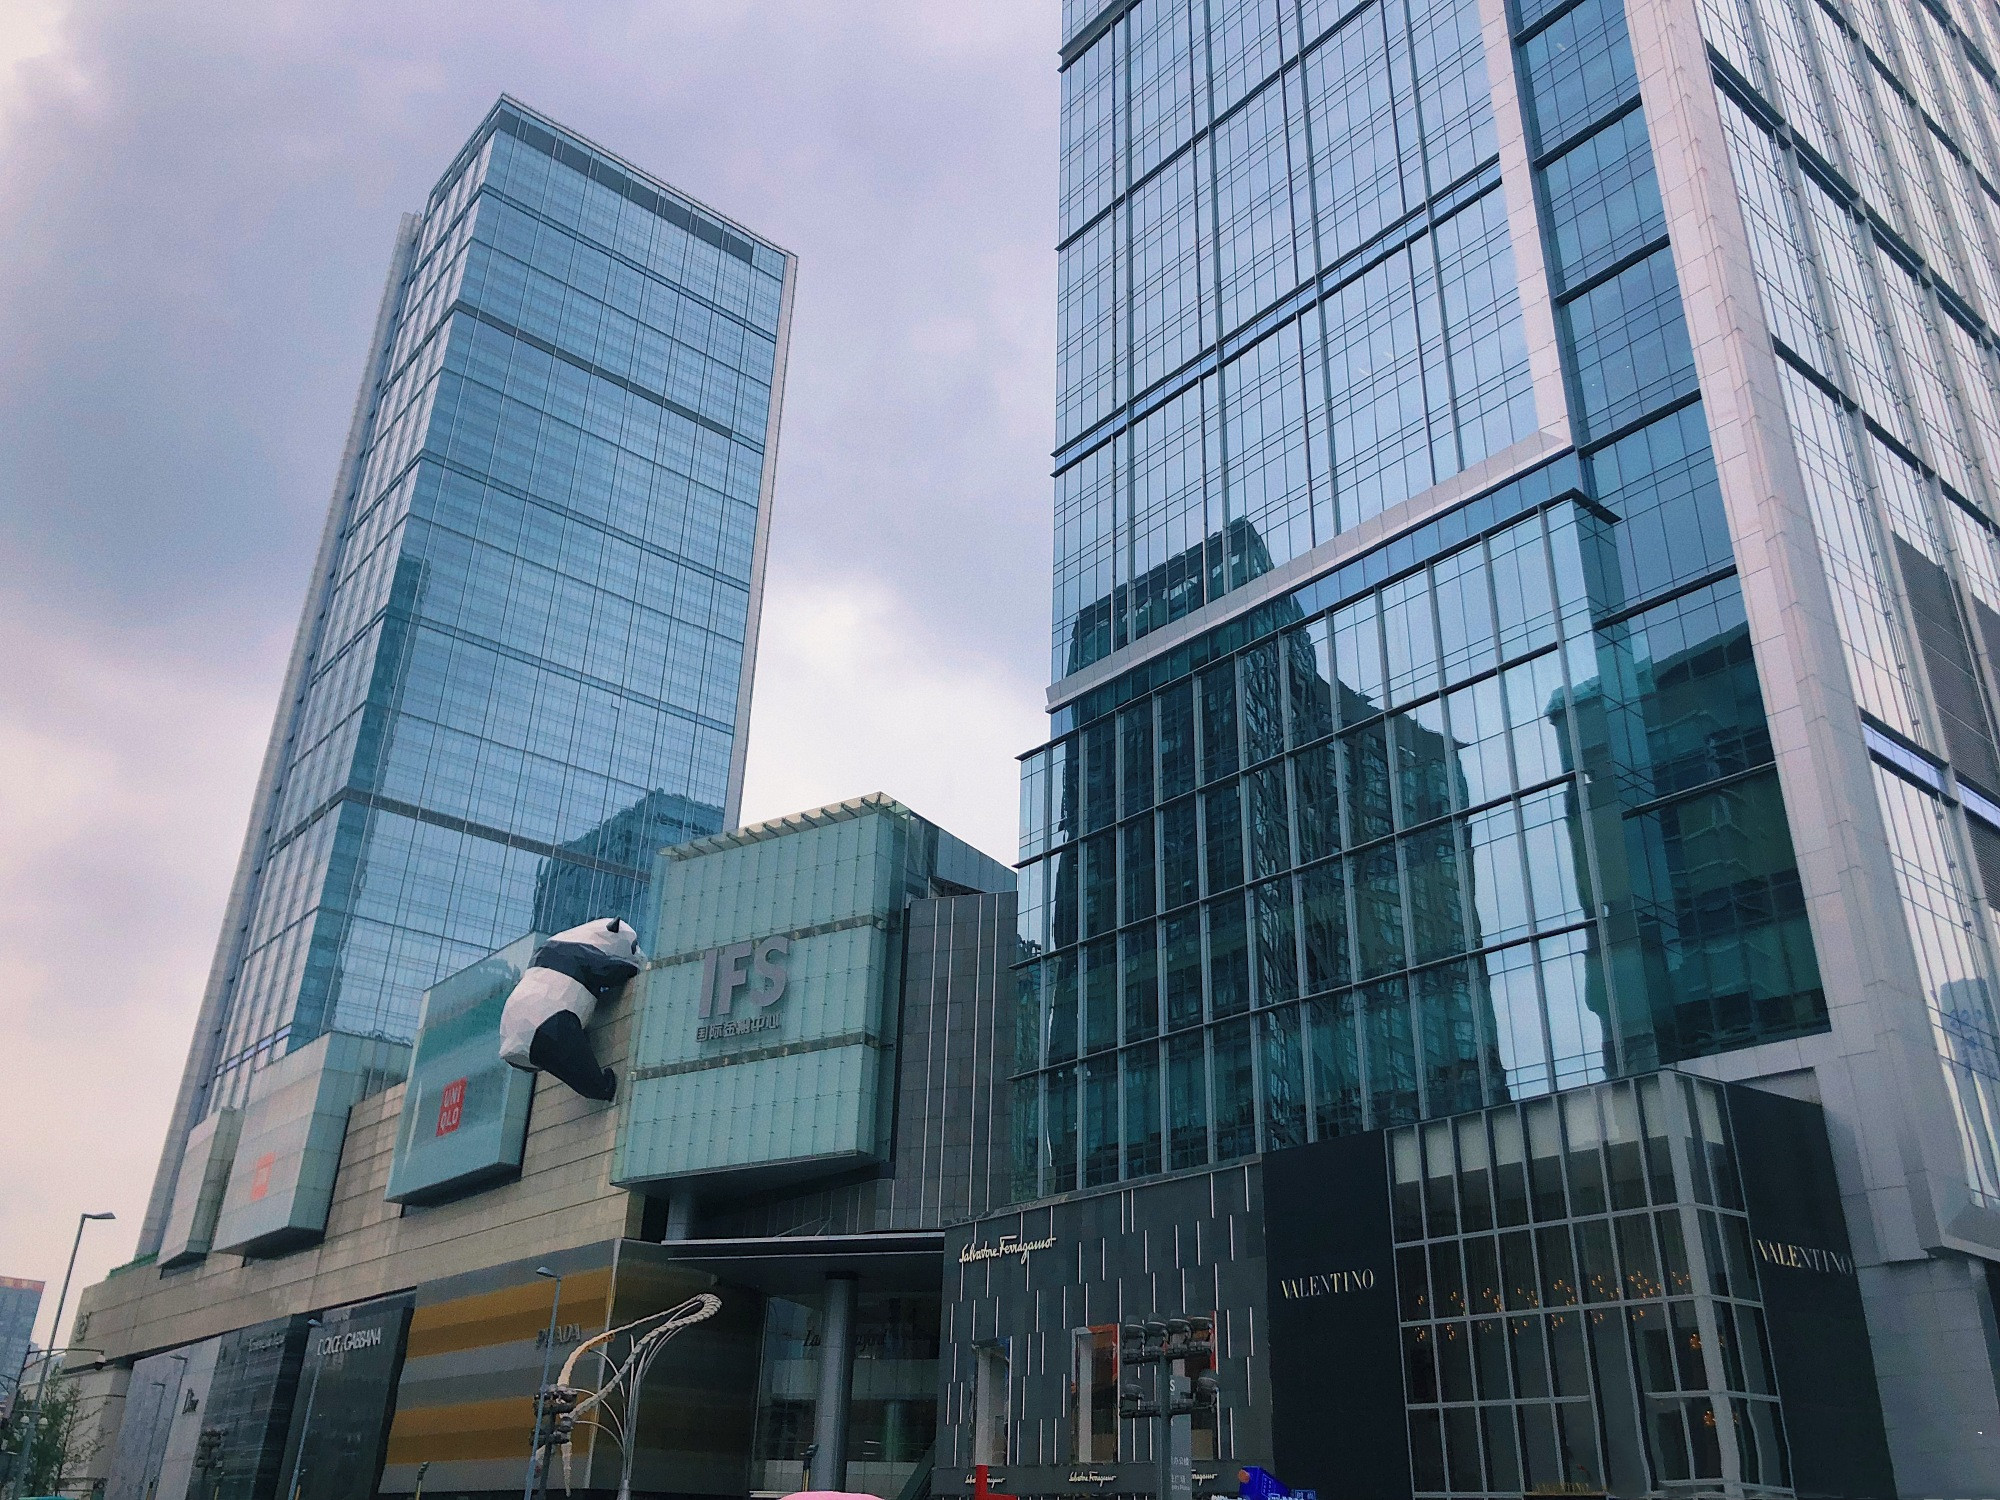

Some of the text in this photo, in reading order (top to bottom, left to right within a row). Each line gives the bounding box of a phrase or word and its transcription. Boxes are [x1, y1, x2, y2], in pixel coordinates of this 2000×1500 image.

[698, 935, 789, 1019] IFS
[697, 1013, 781, 1041] 国际金融中心
[444, 1085, 462, 1107] UNI
[440, 1107, 459, 1130] QLO
[959, 1235, 1056, 1264] Salvatore Ferragamo
[1757, 1239, 1853, 1274] VALENTINO
[1281, 1268, 1374, 1299] VALENTINO
[536, 1323, 580, 1347] PADA
